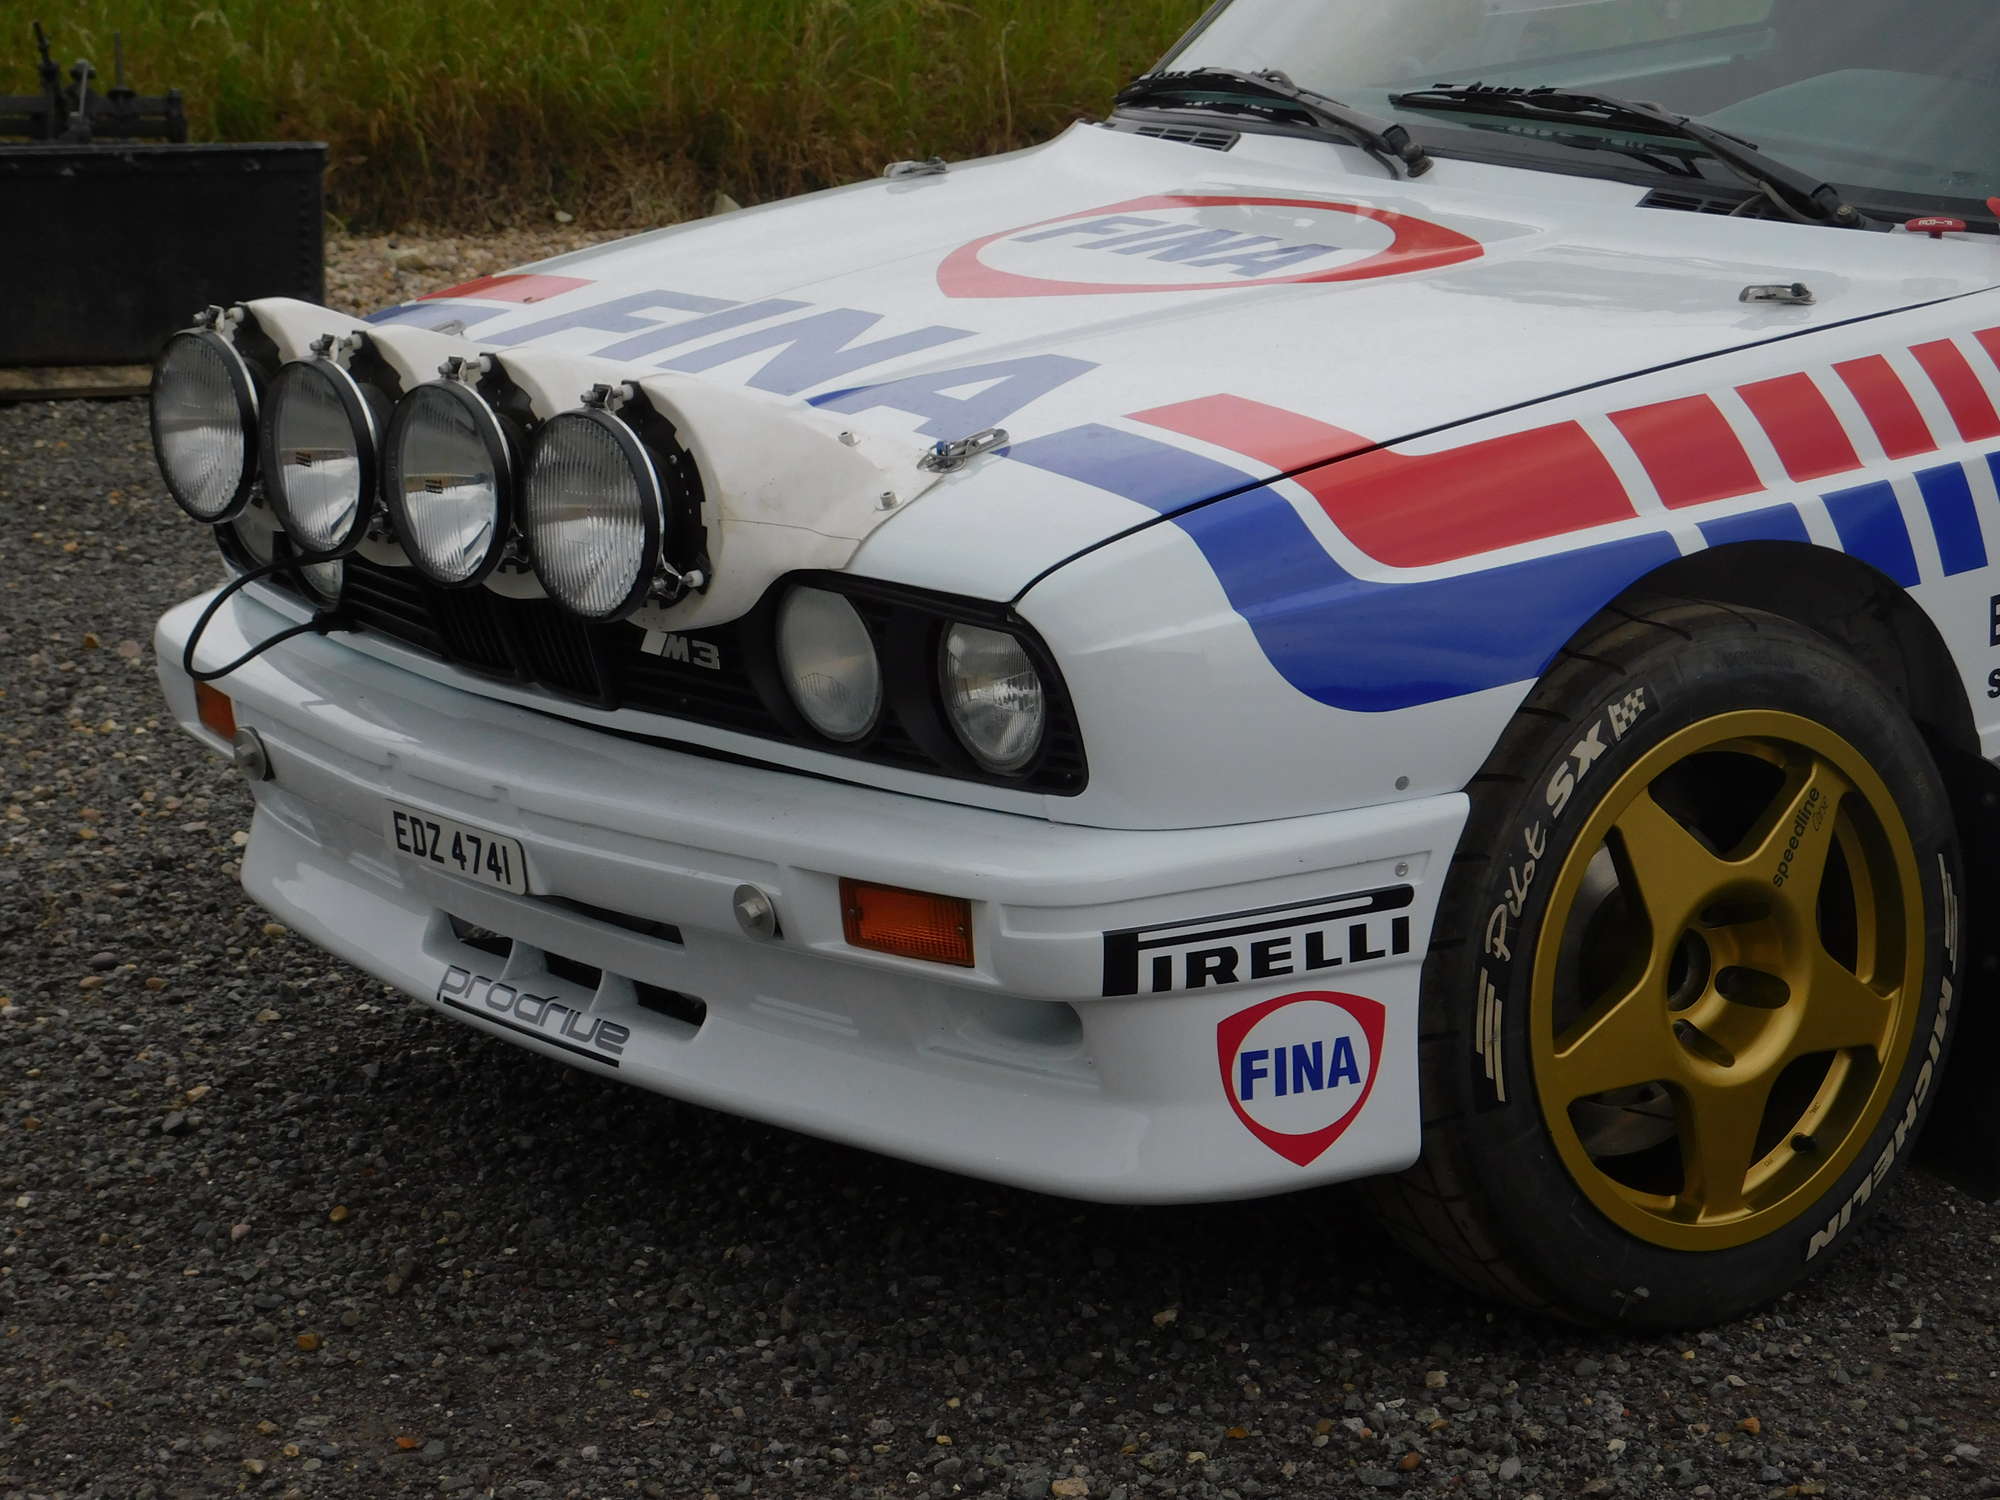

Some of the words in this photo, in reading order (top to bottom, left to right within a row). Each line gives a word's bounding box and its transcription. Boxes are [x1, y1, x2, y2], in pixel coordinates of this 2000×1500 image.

[1008, 215, 1343, 278] FINA
[474, 289, 1103, 440] FINA
[661, 633, 721, 670] M3
[393, 810, 445, 864] EDZ
[451, 831, 511, 885] 4741
[1485, 820, 1547, 962] Pilot
[1546, 719, 1608, 819] SX
[1772, 787, 1820, 888] speedline
[1102, 883, 1414, 997] PIRELLI
[437, 965, 631, 1056] prodrive
[1240, 1036, 1361, 1101] FINA
[1806, 976, 1953, 1262] MICHELIN
